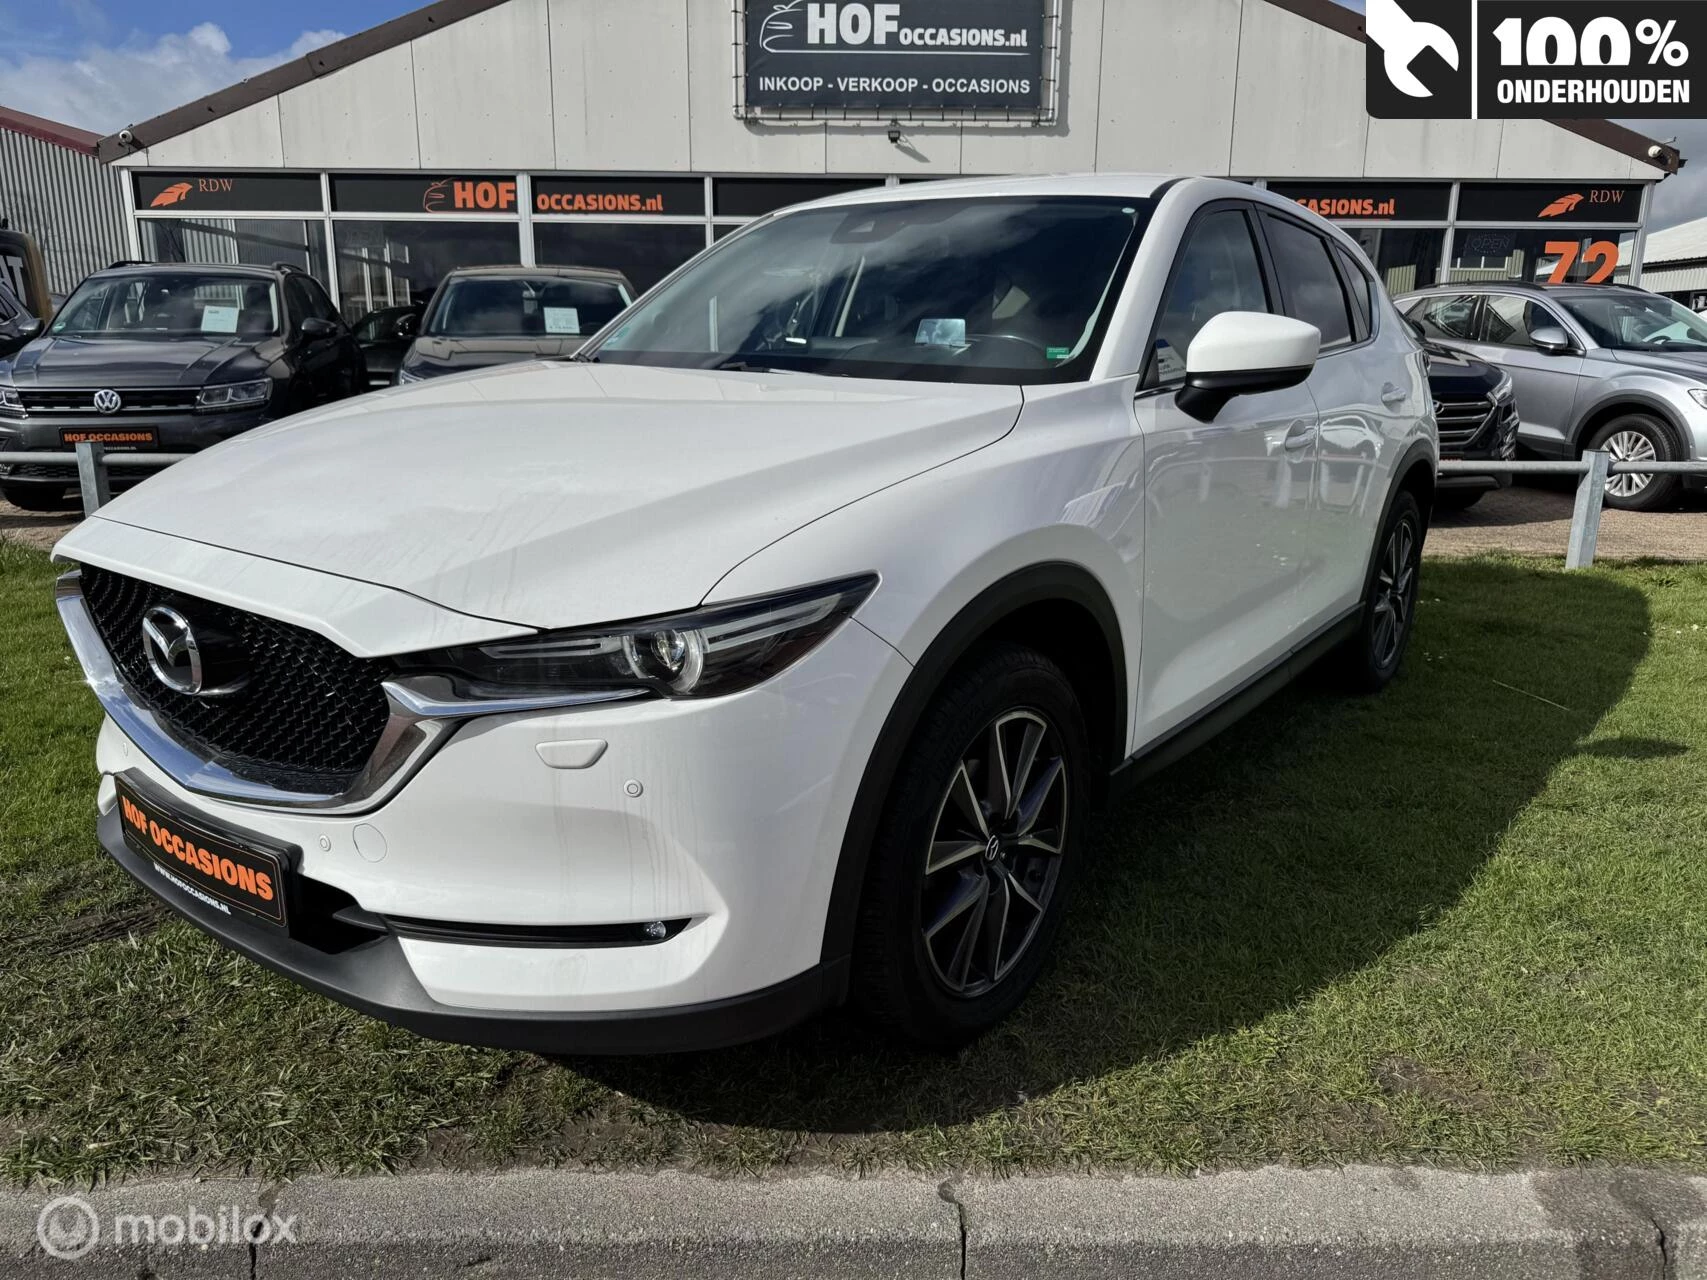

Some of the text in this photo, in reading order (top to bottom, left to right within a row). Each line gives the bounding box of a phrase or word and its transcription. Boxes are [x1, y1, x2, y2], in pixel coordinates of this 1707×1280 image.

[807, 3, 1028, 47] HOF OCCASIONS.nl
[759, 77, 823, 91] INKOOP
[837, 77, 918, 92] VERKOOP
[932, 79, 1030, 94] OCCASIONS
[198, 178, 233, 192] RDW
[453, 181, 663, 211] HOF OCCASIONS.nl
[1589, 189, 1625, 203] RDW
[1544, 240, 1620, 284] 72
[64, 432, 153, 442] HOF OCCASIONS
[122, 795, 274, 901] HOF OCCASIONS
